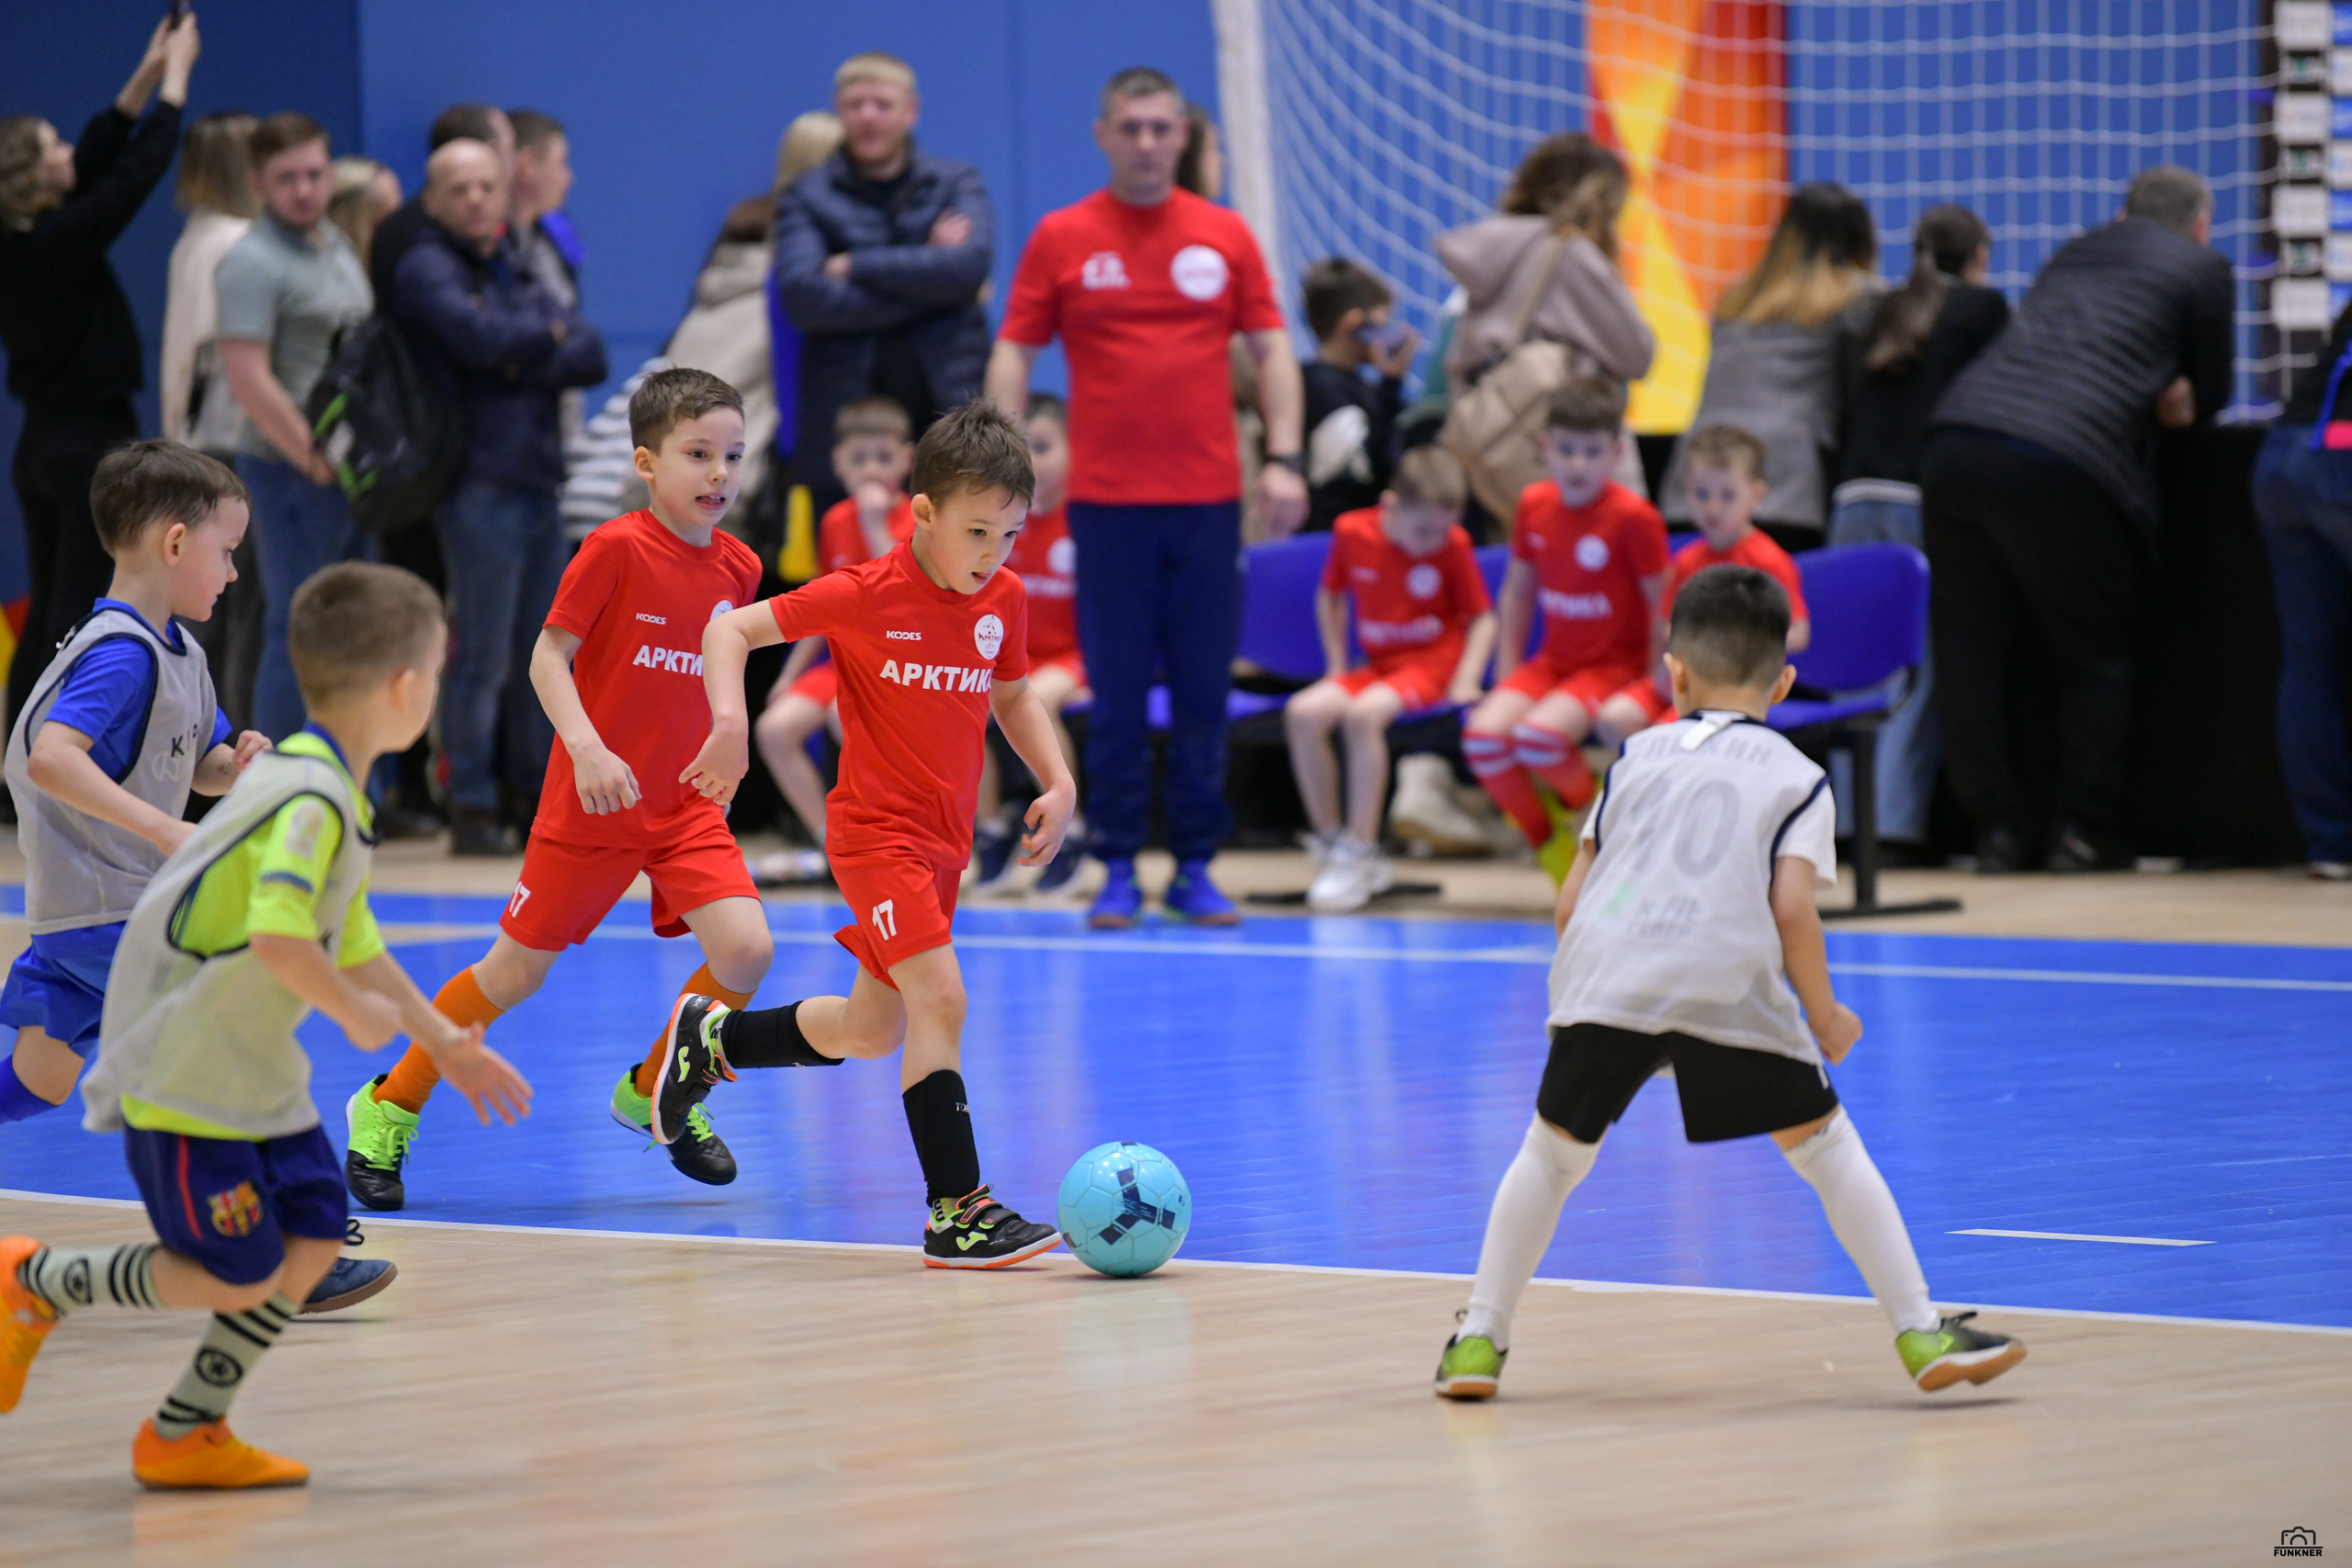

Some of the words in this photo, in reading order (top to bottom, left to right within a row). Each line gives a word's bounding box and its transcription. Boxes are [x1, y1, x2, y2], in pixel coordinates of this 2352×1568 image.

[635, 612, 667, 625] KODES
[886, 629, 922, 641] KODES
[508, 880, 532, 919] 17
[872, 898, 898, 942] 17
